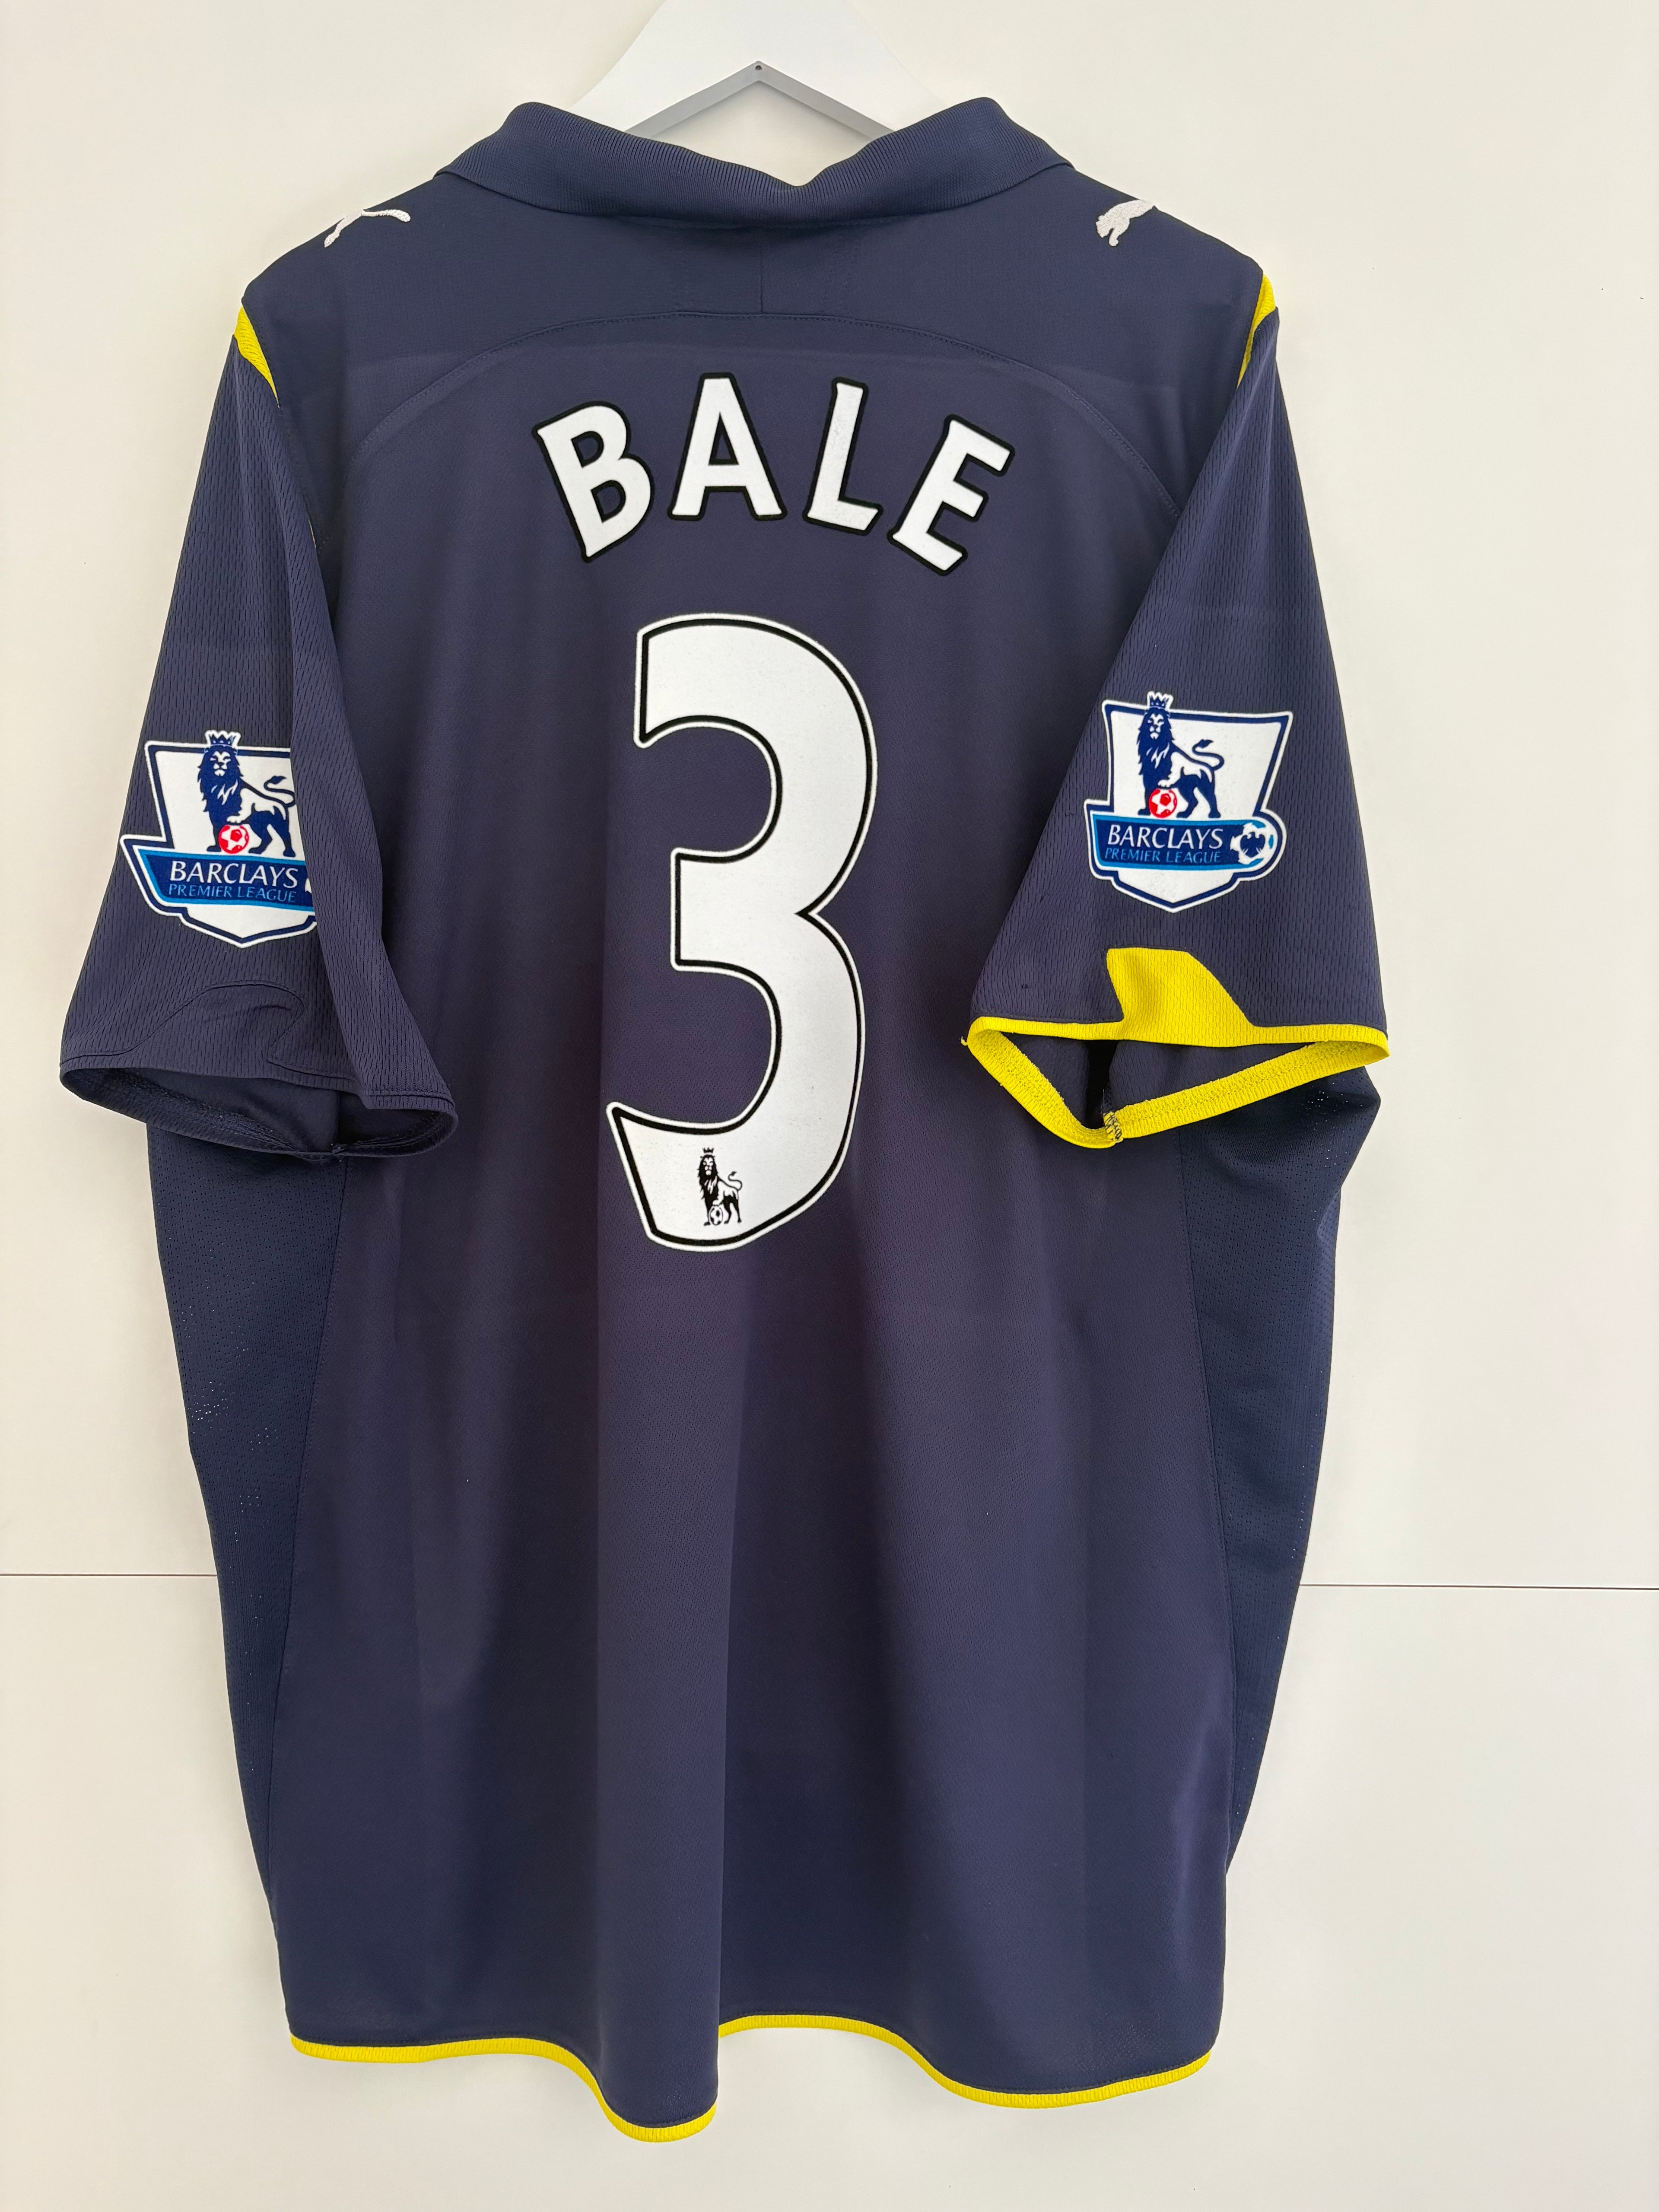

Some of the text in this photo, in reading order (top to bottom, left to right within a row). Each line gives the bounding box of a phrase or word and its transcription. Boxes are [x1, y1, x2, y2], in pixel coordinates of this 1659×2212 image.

[532, 373, 1014, 575] BALE
[1108, 824, 1224, 849] BARCLAYS
[1105, 848, 1221, 863] PREMIER LEAGUE
[170, 860, 298, 889] BARCLAYS
[168, 883, 297, 903] PREMIER LEAGUE
[606, 613, 877, 1252] 3
